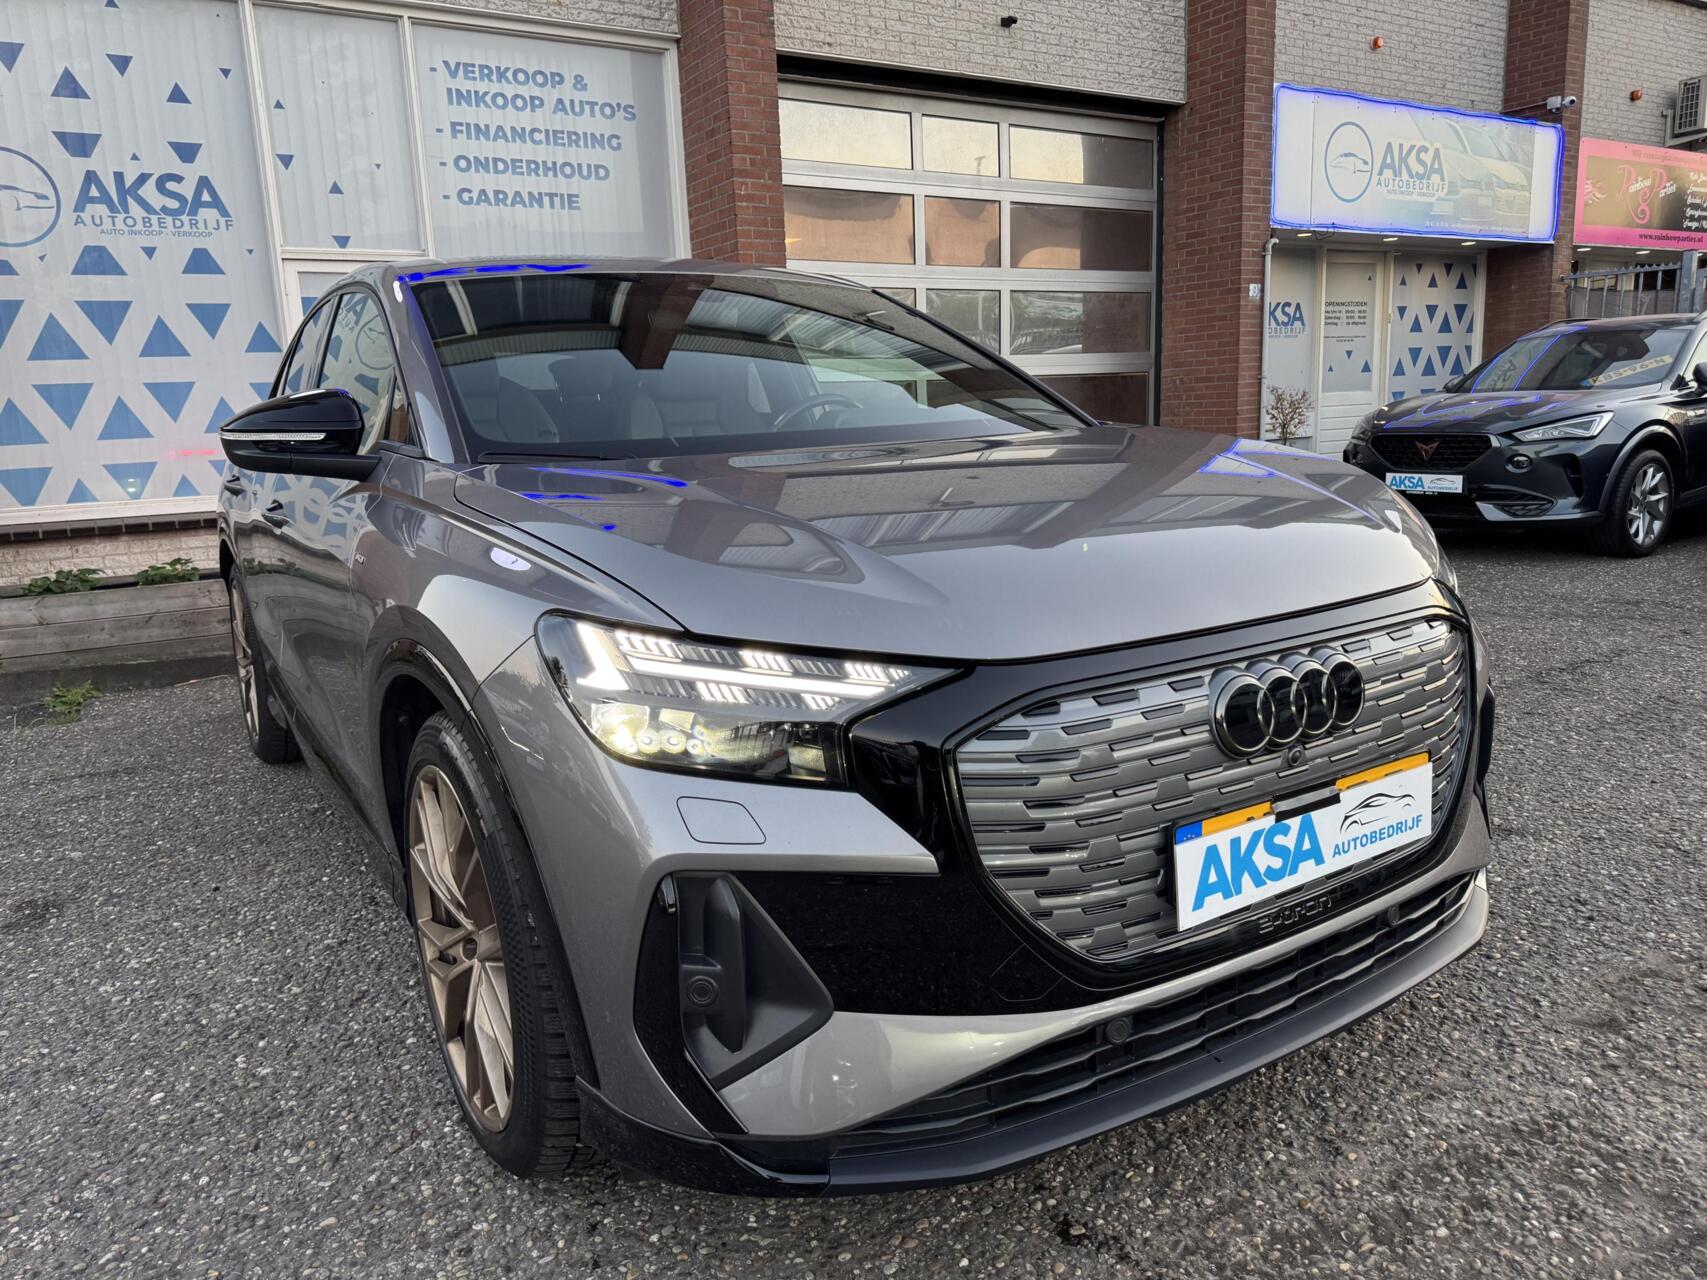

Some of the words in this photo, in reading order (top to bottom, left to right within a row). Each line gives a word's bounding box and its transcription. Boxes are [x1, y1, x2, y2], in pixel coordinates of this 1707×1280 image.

[442, 60, 565, 89] VERKOOP
[572, 74, 588, 92] &
[446, 87, 545, 113] INKOOP
[552, 97, 637, 122] AUTO'S
[450, 121, 622, 151] FINANCIERING
[453, 154, 610, 181] ONDERHOUD
[1376, 141, 1446, 182] AKSA
[72, 169, 233, 218] AKSA
[1376, 176, 1447, 193] AUTOBEDRIJF
[456, 187, 581, 211] GARANTIE
[73, 214, 234, 231] AUTOBEDRIJF
[100, 228, 126, 236] AUTO
[127, 229, 164, 237] INKOOP
[170, 230, 213, 238] VERKOOP
[1268, 301, 1305, 327] KSA
[1389, 475, 1425, 490] AKSA
[1331, 813, 1424, 859] AUTOBEDRIJF
[1191, 812, 1325, 912] AKSA
